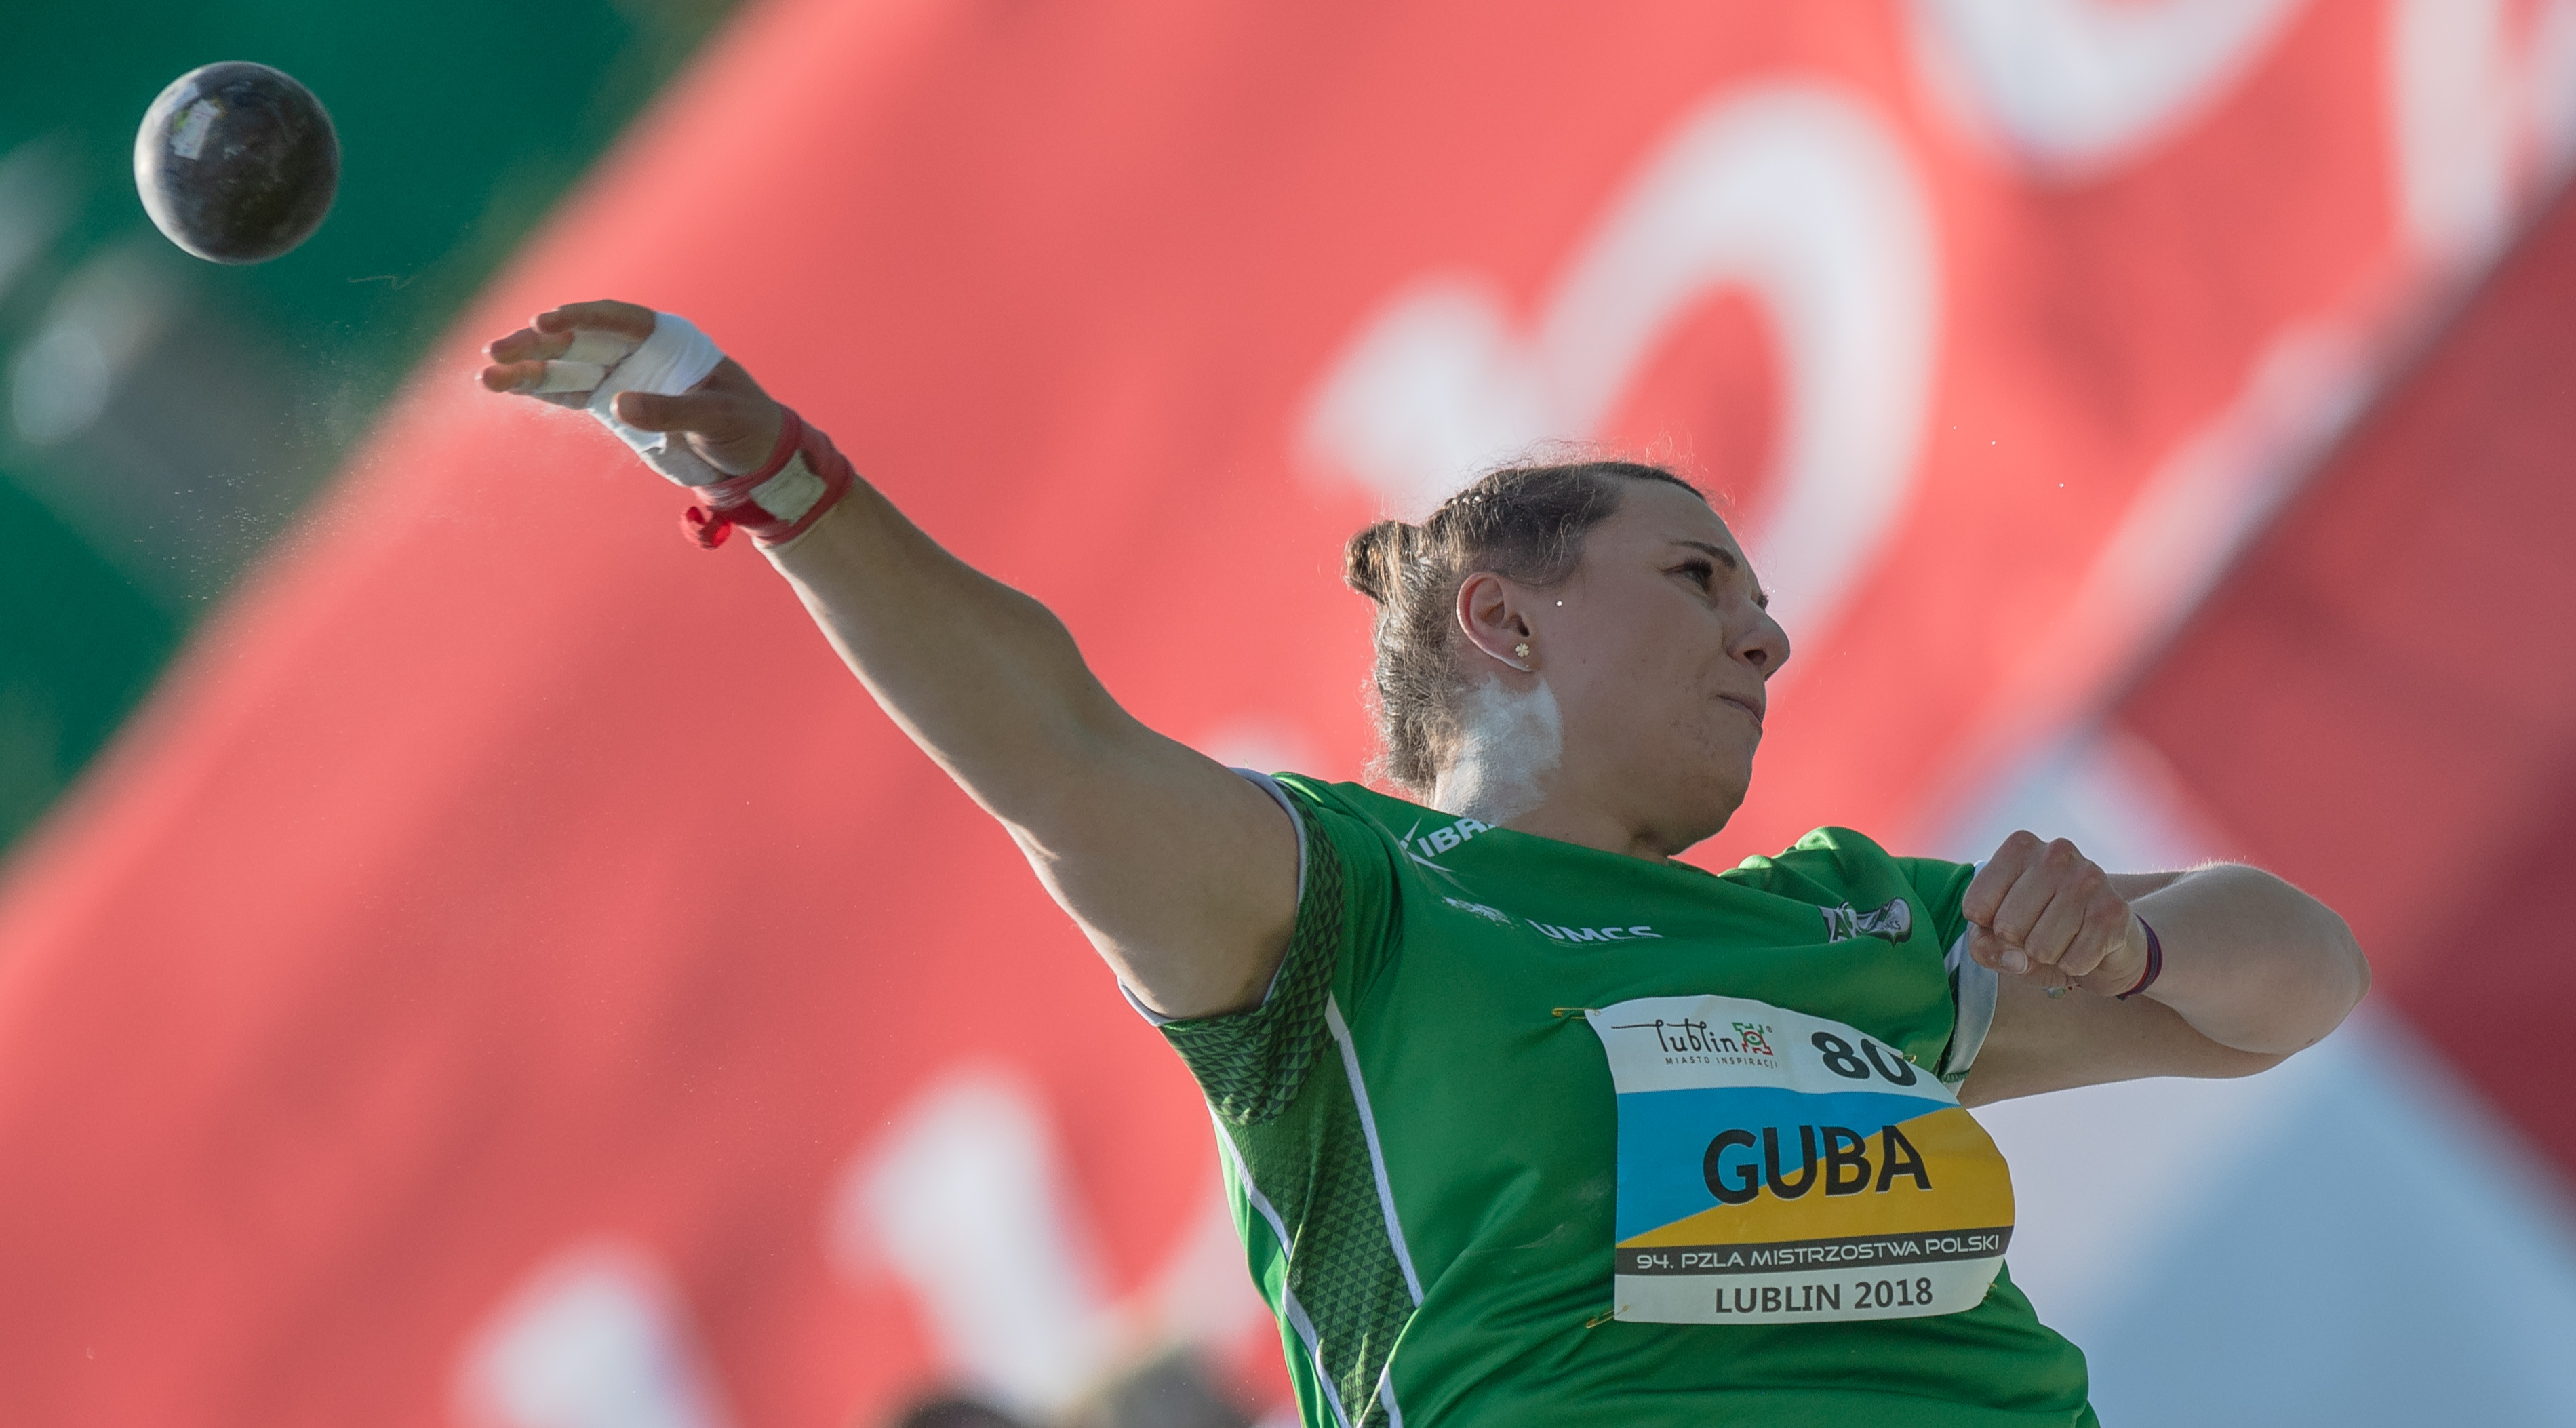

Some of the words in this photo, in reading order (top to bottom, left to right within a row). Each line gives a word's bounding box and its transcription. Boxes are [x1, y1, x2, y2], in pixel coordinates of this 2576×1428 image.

[1665, 1056, 1710, 1065] MIASTO
[1716, 1057, 1778, 1069] INSPIRACJI
[1811, 1031, 1917, 1086] 80
[1703, 1124, 1932, 1205] GUBA
[1636, 1254, 1674, 1269] 94.
[1681, 1252, 1745, 1268] PZLA
[1750, 1240, 1921, 1267] MISTRZOSTWA
[1925, 1235, 2000, 1254] POLSKI
[1716, 1283, 1840, 1313] LUBLIN
[1854, 1277, 1933, 1309] 2018
